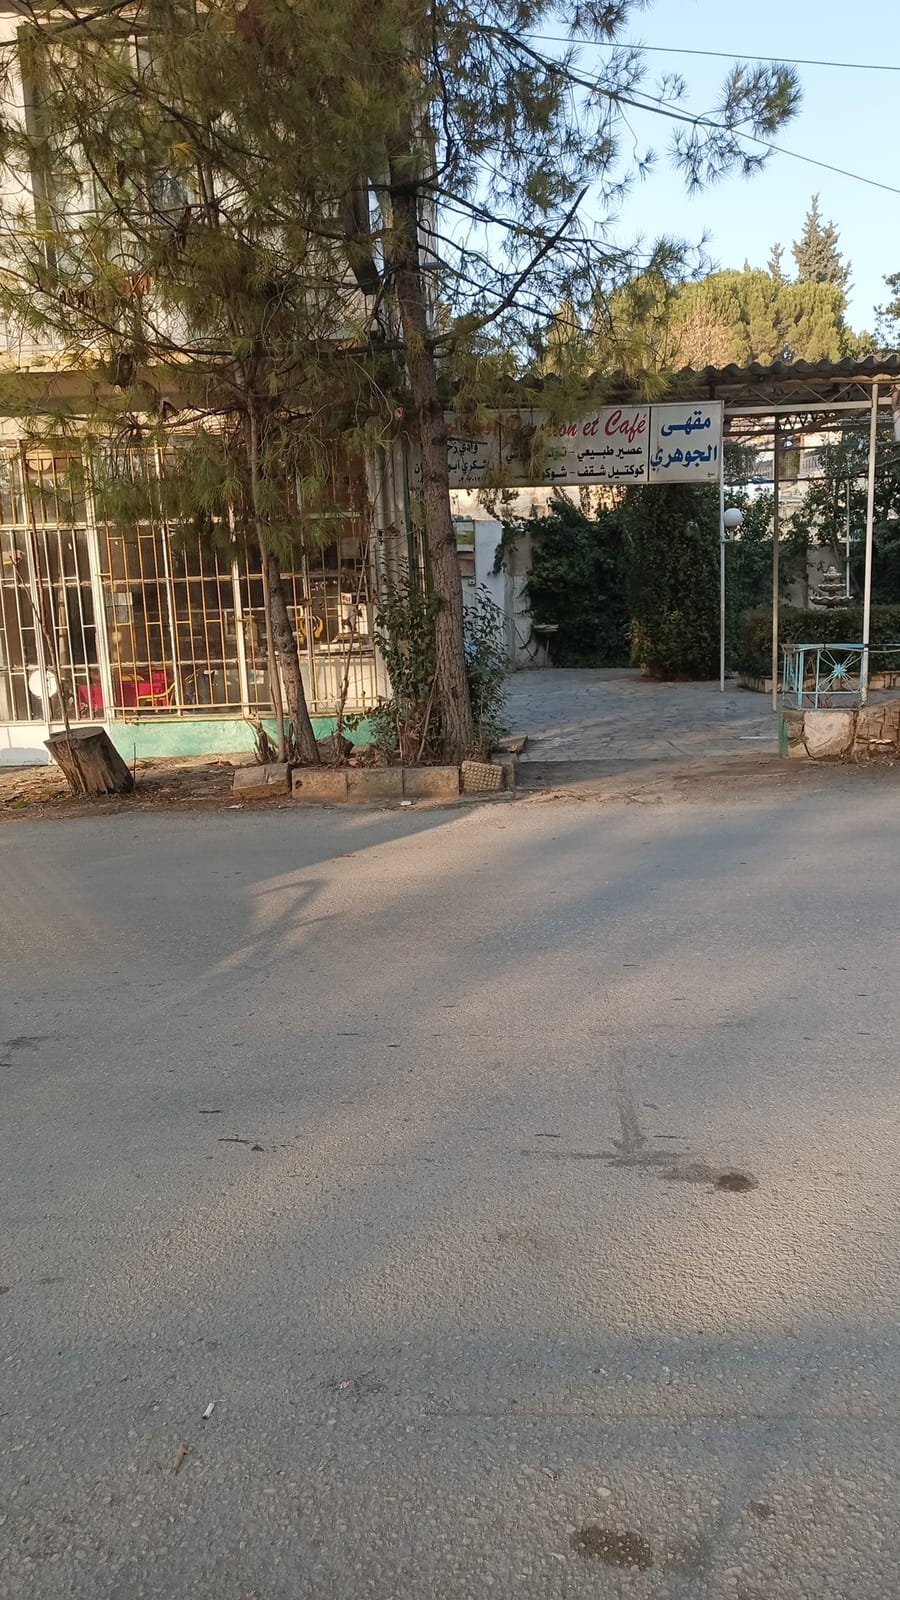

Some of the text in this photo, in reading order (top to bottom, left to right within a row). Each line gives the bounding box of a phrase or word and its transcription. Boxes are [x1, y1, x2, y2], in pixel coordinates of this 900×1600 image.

[582, 417, 600, 436] et
[604, 409, 647, 443] Café
[661, 410, 711, 436] مقهى
[577, 445, 614, 461] طبيعي
[615, 444, 642, 459] عصير
[650, 444, 717, 471] الجوهري
[577, 465, 606, 477] شقف
[608, 464, 645, 479] كوكتيل
